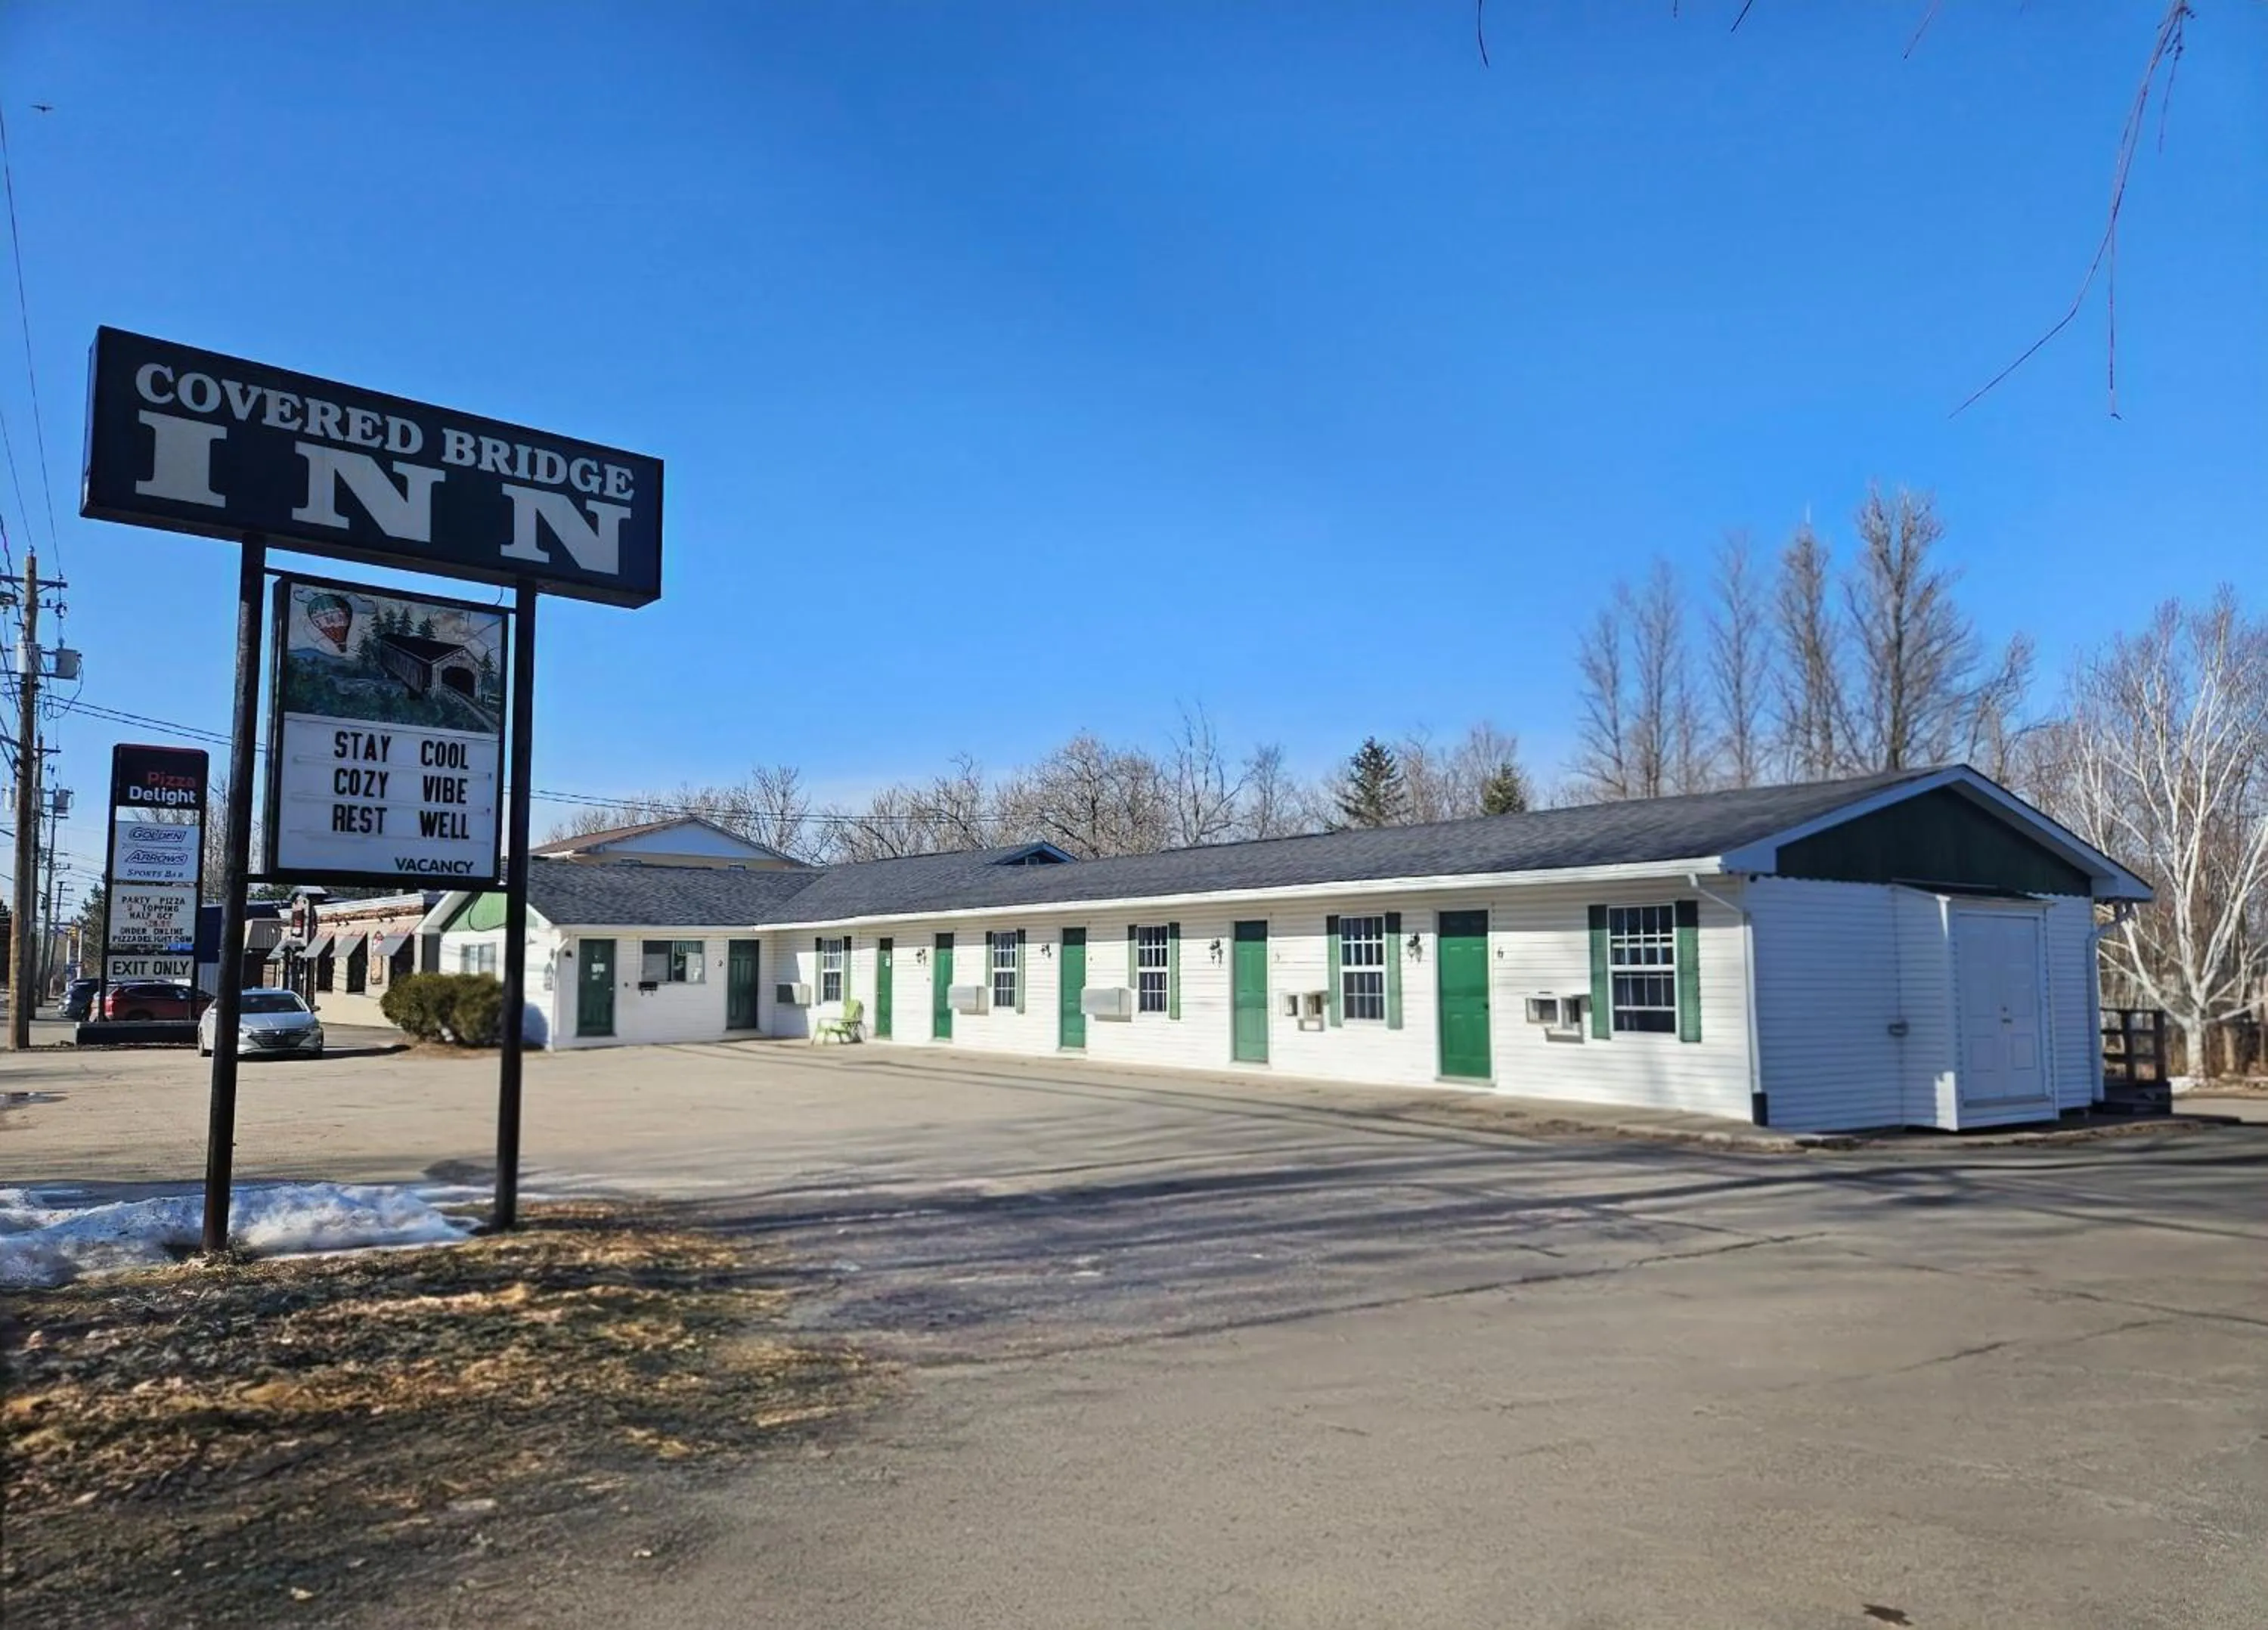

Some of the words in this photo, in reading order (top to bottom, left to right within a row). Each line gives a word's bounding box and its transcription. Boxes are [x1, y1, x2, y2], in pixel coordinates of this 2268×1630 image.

[136, 363, 423, 454] COVERED
[442, 427, 635, 501] BRIDGE
[135, 410, 631, 575] INN
[334, 731, 392, 763] STAY
[420, 740, 469, 770] COOL
[147, 771, 197, 787] Pizza
[334, 768, 390, 799] COZY
[423, 775, 468, 804] VIBE
[129, 786, 197, 805] Delight
[332, 805, 387, 835] REST
[420, 810, 469, 840] WELL
[132, 829, 184, 841] GOLDEN
[129, 851, 185, 863] ARROWS
[395, 857, 474, 874] VACANCY
[122, 896, 150, 904] PARTY
[120, 927, 147, 935] ORDER
[113, 961, 149, 975] EXIT
[153, 961, 189, 975] ONLY
